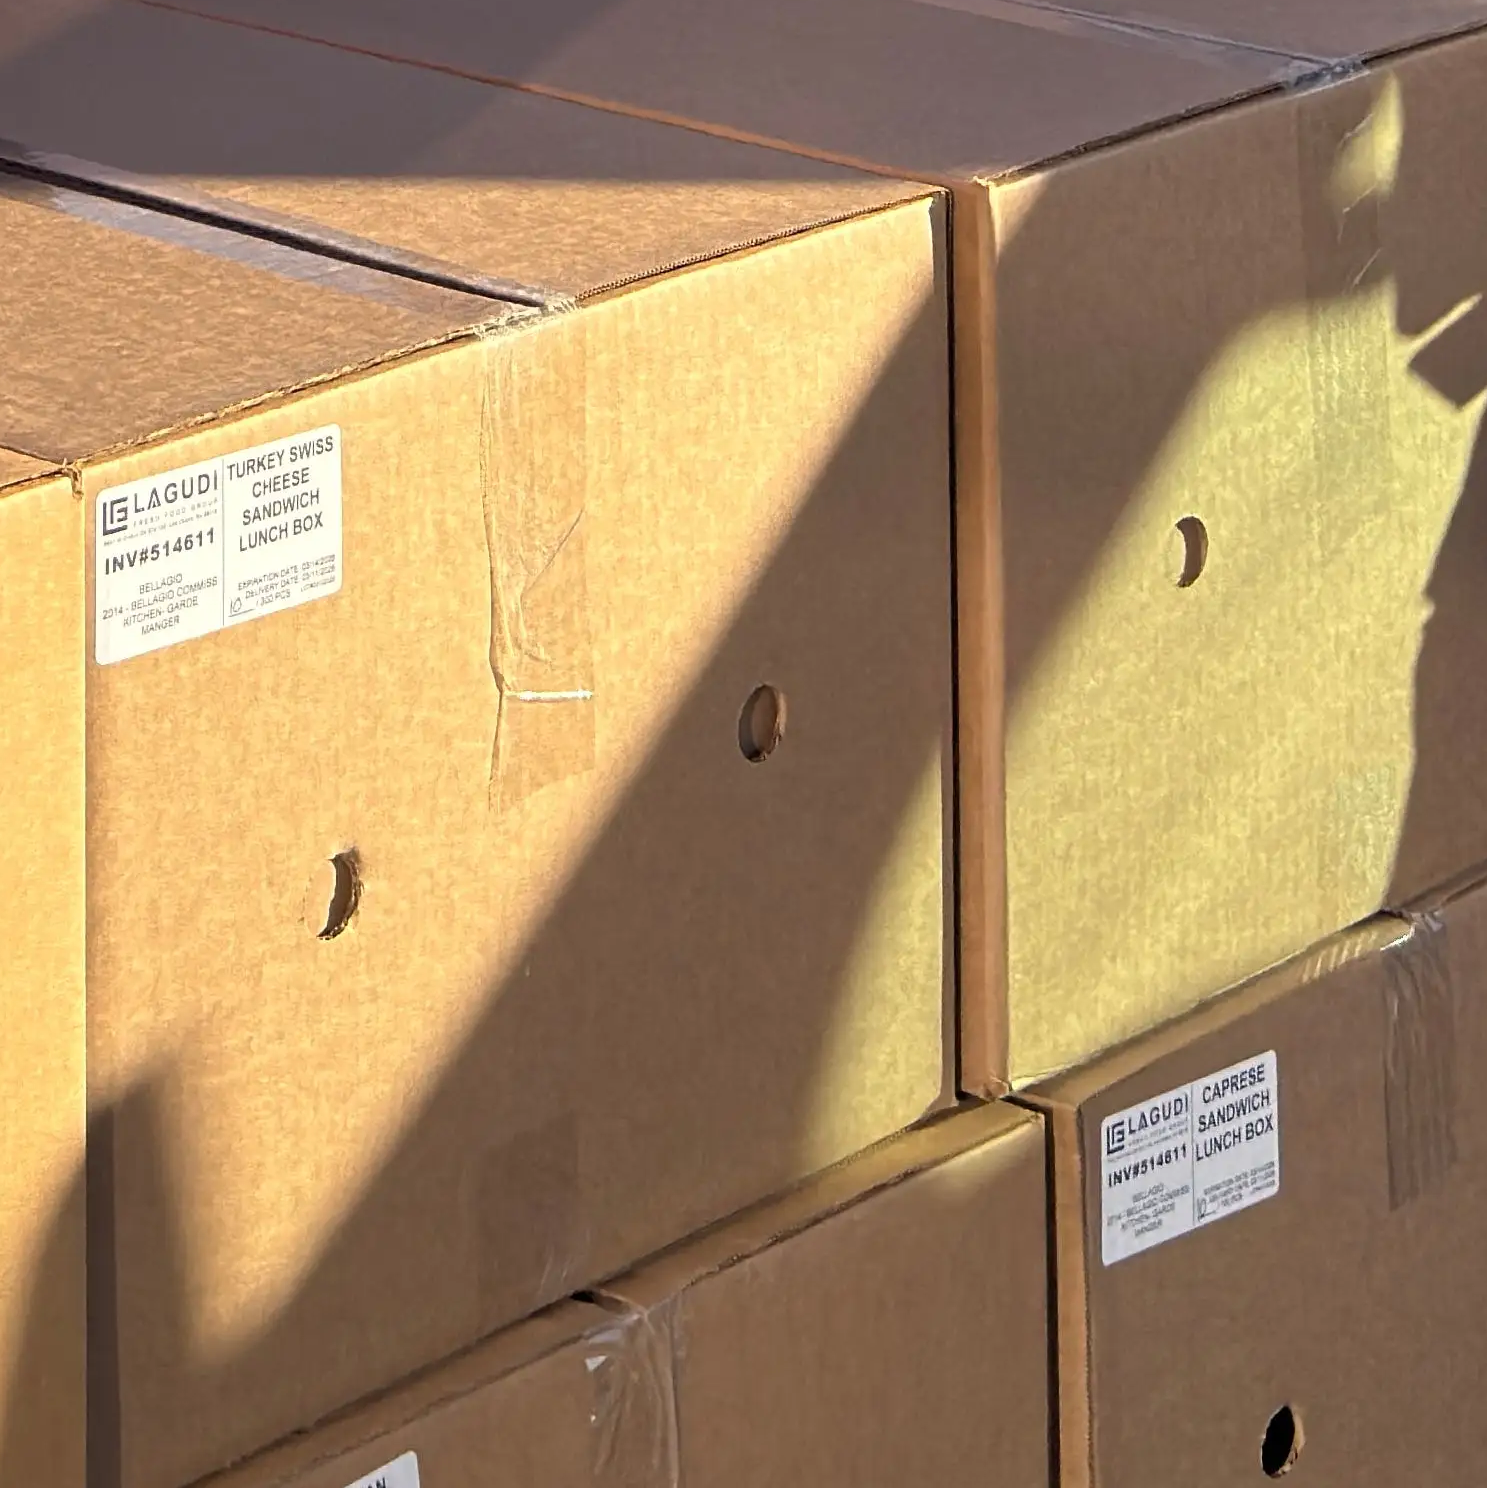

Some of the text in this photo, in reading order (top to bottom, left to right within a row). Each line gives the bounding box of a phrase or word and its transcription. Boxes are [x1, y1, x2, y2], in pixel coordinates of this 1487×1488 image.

[227, 436, 333, 480] TURKEY SWISS
[134, 470, 218, 514] LAGUDI
[253, 467, 310, 498] CHEESE
[242, 489, 319, 525] SANDWICH
[105, 527, 215, 575] INV#514611
[240, 512, 323, 552] LUNCH BOX
[131, 588, 174, 610] BELLAGIO
[140, 573, 182, 594] BELLAGIO
[142, 615, 180, 635] MANGER
[167, 596, 198, 614] GARDE
[1203, 1064, 1265, 1104] CAPRESE
[1128, 1092, 1188, 1135] LAGUDI
[1198, 1089, 1270, 1133] SANDWICH
[1196, 1131, 1241, 1162] LUNCH
[1246, 1113, 1274, 1141] BOX
